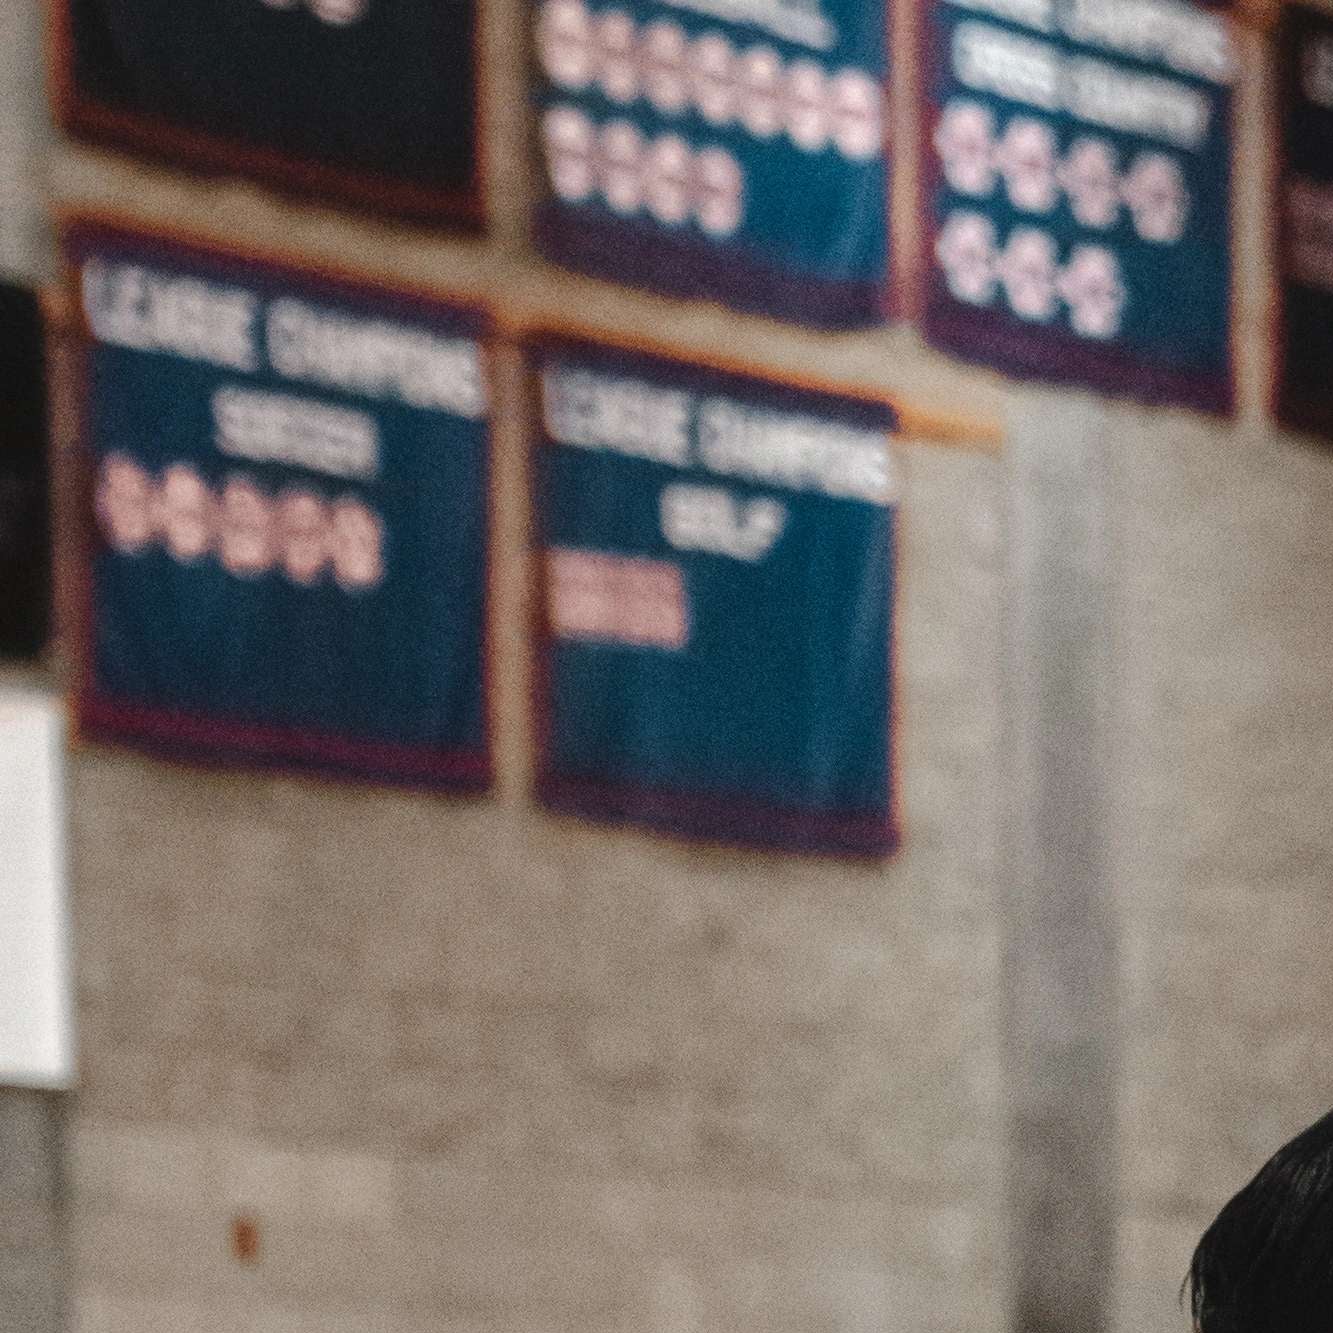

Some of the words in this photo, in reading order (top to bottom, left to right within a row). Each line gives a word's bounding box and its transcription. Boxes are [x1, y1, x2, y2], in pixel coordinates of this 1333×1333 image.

[83, 258, 258, 371] LEAGUE
[266, 297, 488, 420] CHAMPIONS
[543, 362, 693, 468] LEAGUE
[697, 398, 897, 506] CHAMPIONS
